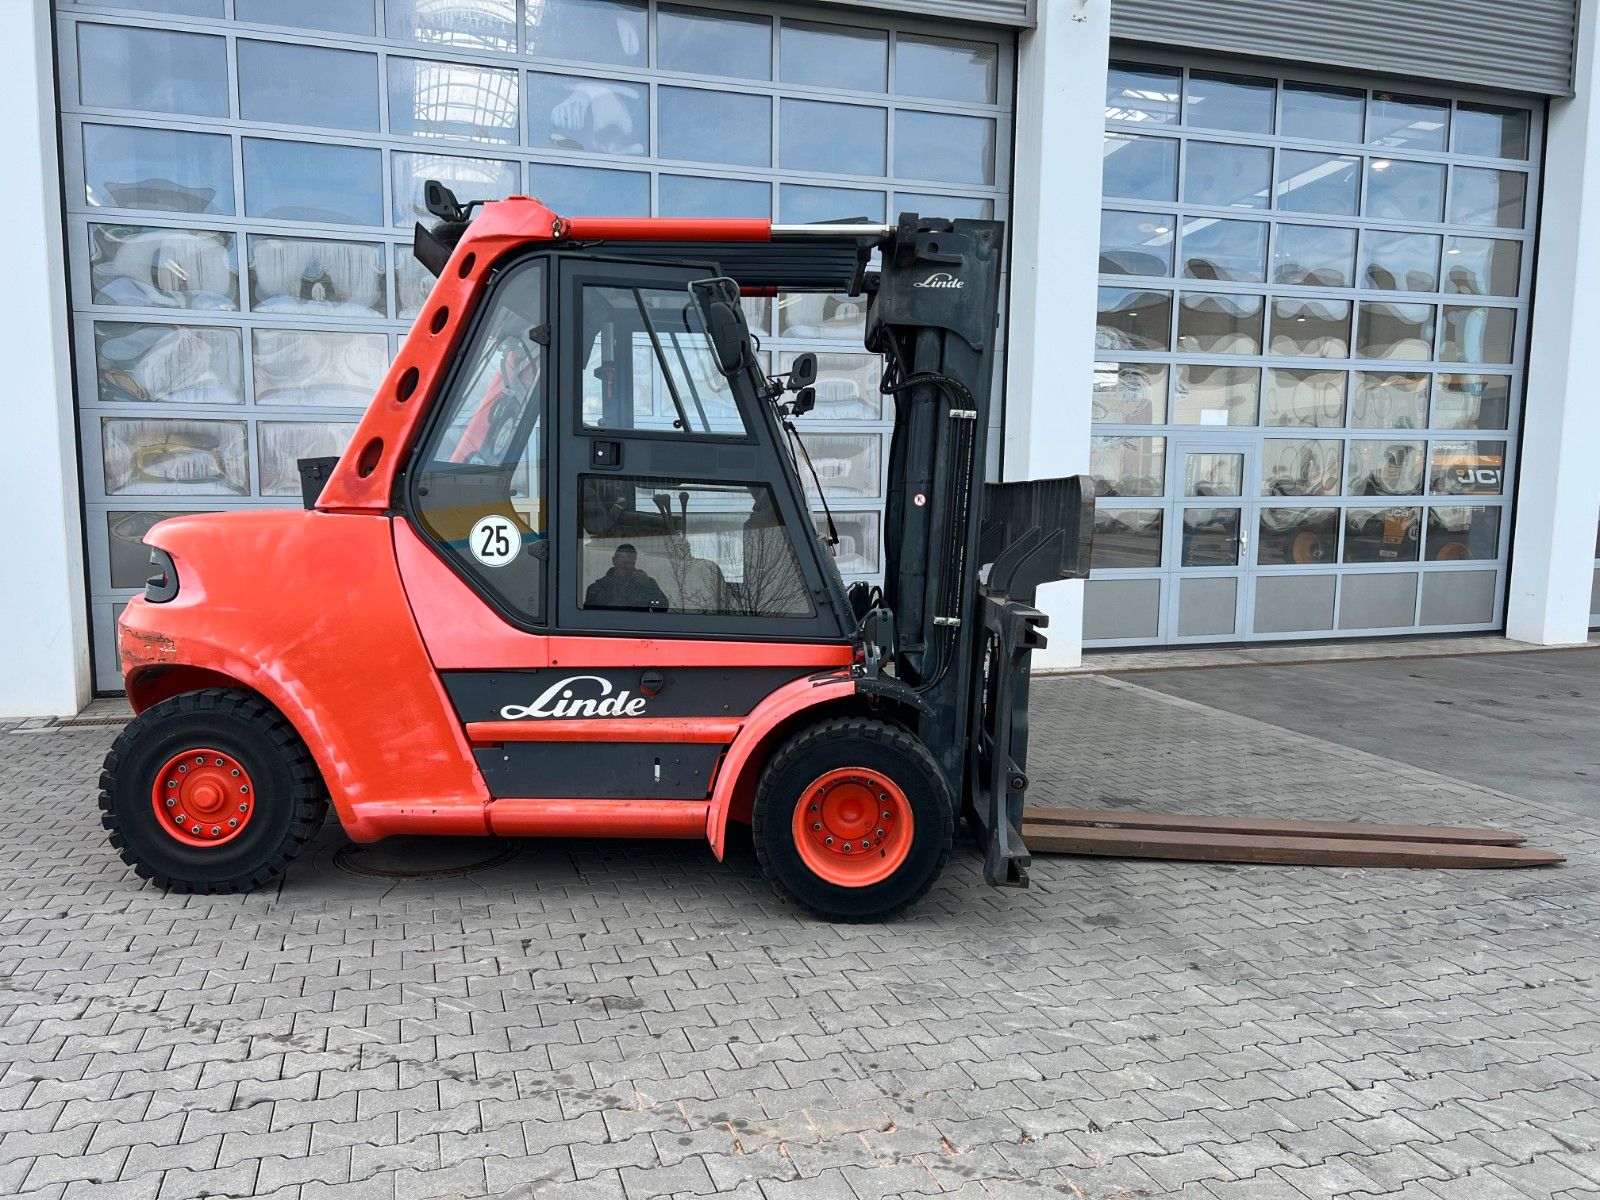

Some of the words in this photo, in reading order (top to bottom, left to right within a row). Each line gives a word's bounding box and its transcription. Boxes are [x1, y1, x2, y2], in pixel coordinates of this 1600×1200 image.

[913, 272, 965, 289] Linde
[480, 525, 510, 557] 25
[500, 675, 646, 720] Linde
